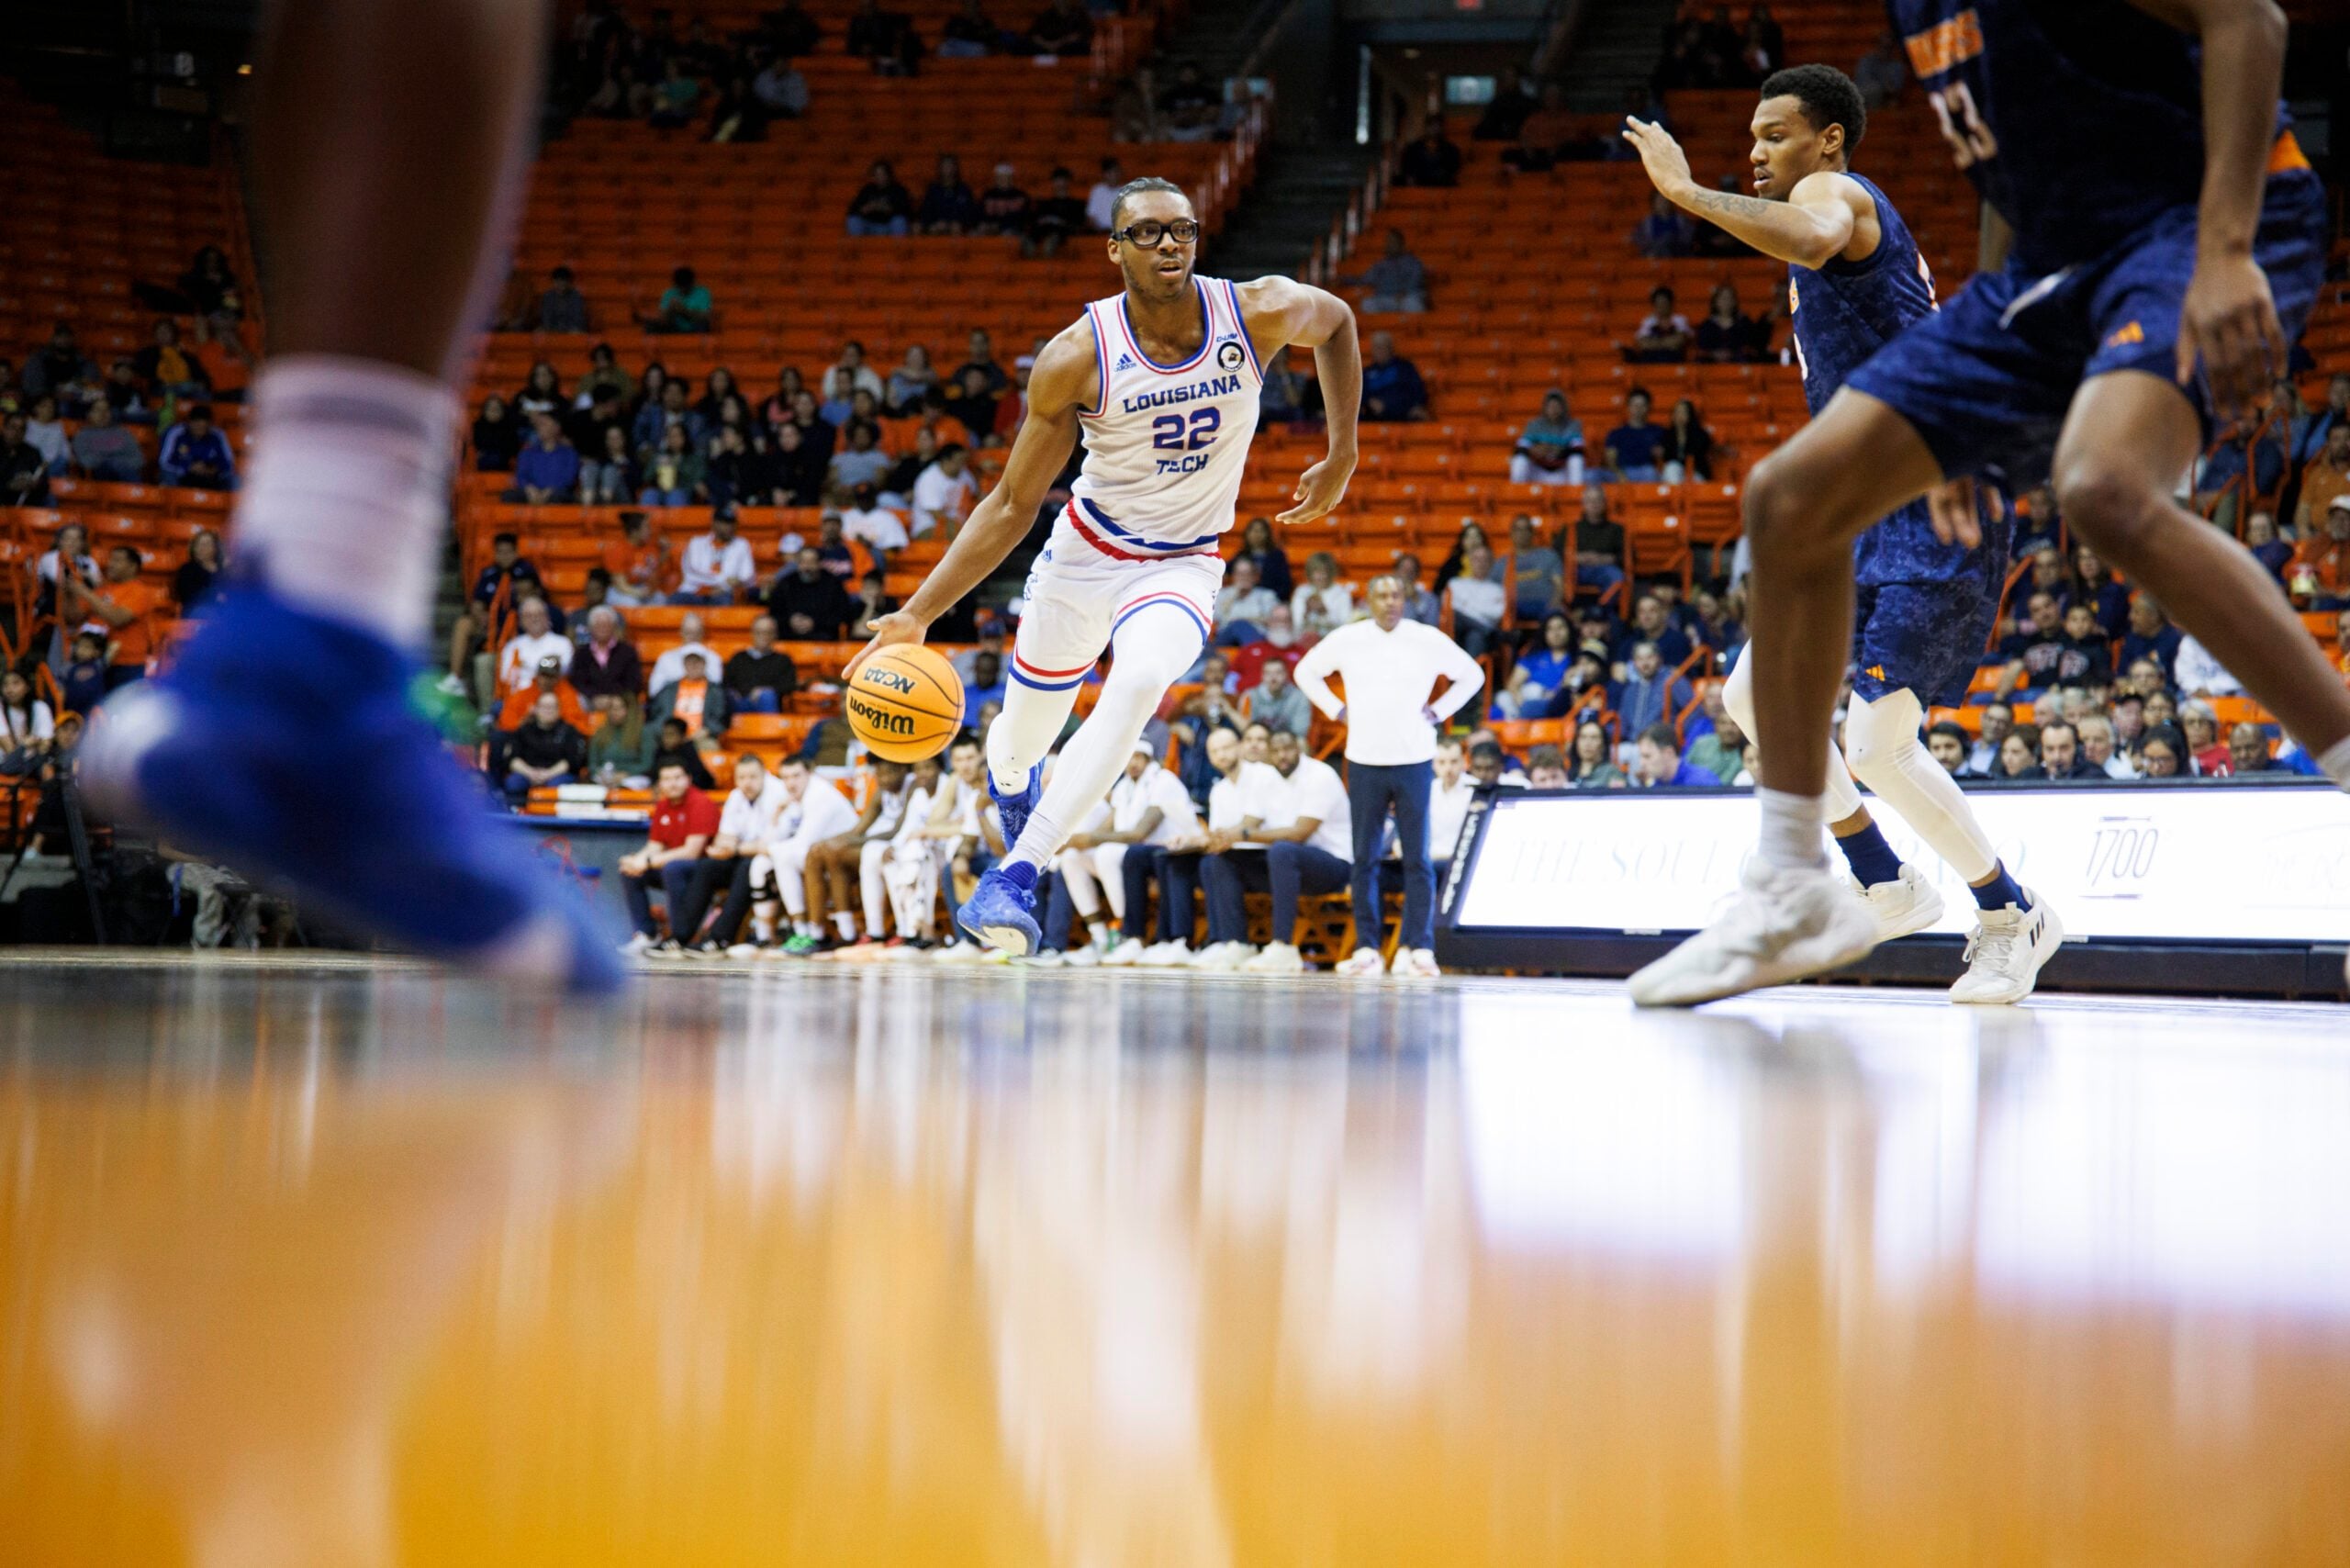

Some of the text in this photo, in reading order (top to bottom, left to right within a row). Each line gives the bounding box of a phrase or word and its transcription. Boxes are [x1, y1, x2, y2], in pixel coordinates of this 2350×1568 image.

[1123, 374, 1241, 413] LOUISIANA
[1152, 406, 1221, 451] 22
[1156, 454, 1209, 476] TECH
[864, 667, 915, 695] NCAA
[850, 695, 914, 734] Wilson
[2086, 827, 2159, 887] 1700
